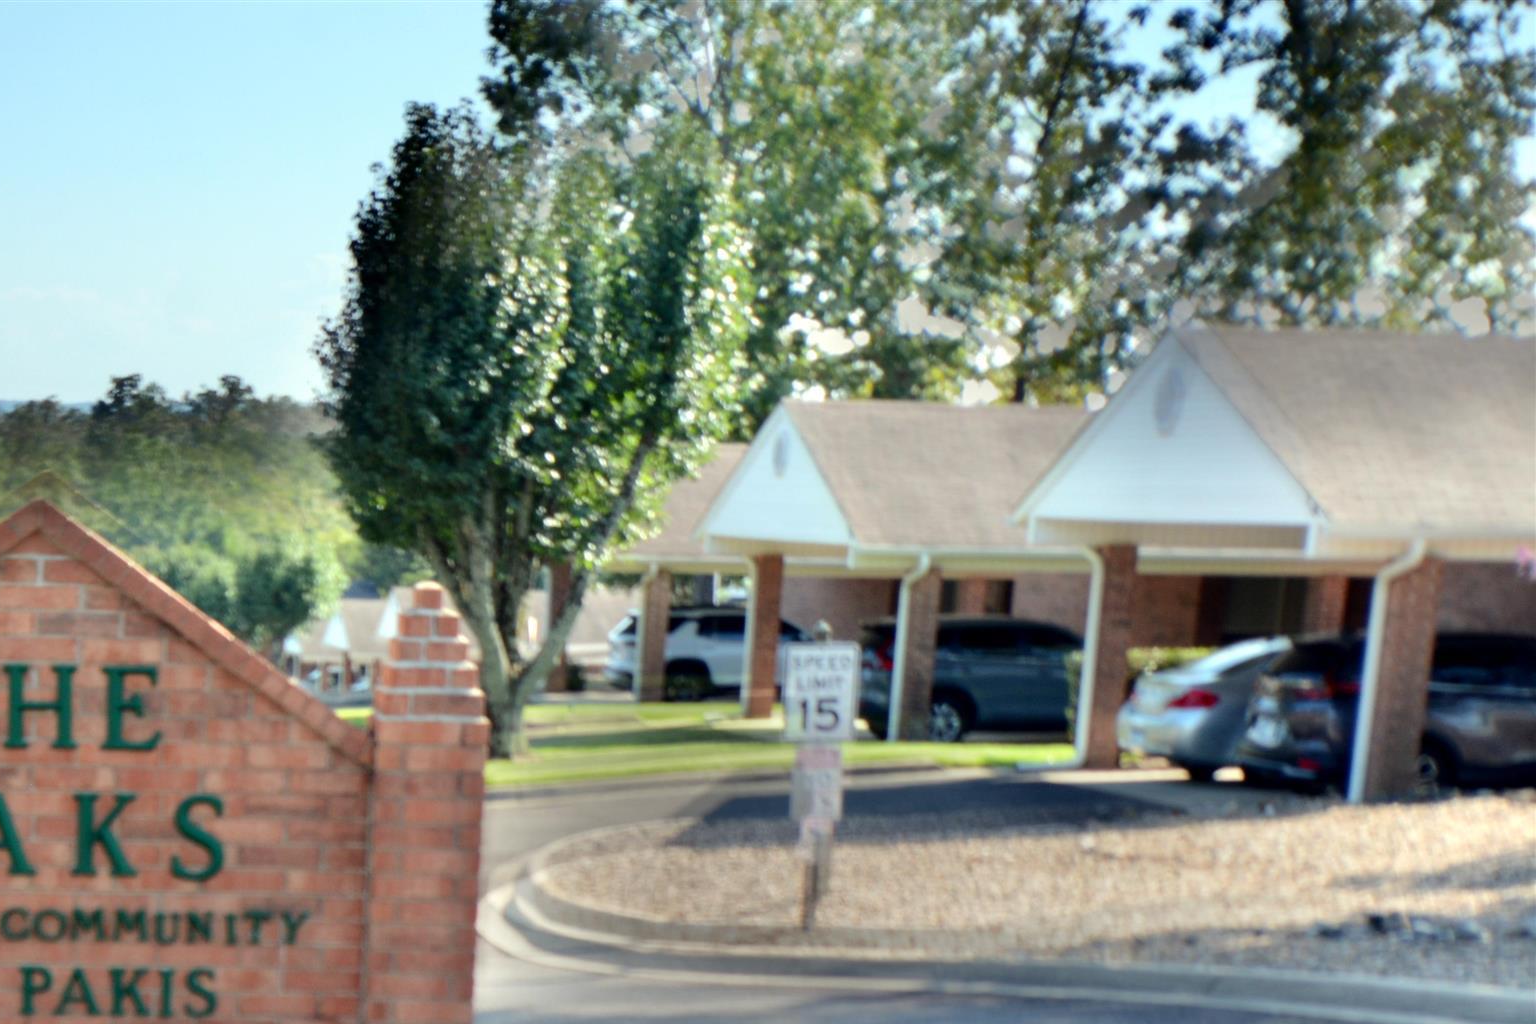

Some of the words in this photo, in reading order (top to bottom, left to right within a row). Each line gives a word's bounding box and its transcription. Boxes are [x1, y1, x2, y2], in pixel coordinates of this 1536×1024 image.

[792, 653, 852, 672] SPEED
[796, 675, 844, 692] LIMIT
[800, 699, 841, 732] 15
[0, 906, 308, 946] COMMUNITY
[18, 965, 220, 1019] PAKIS
